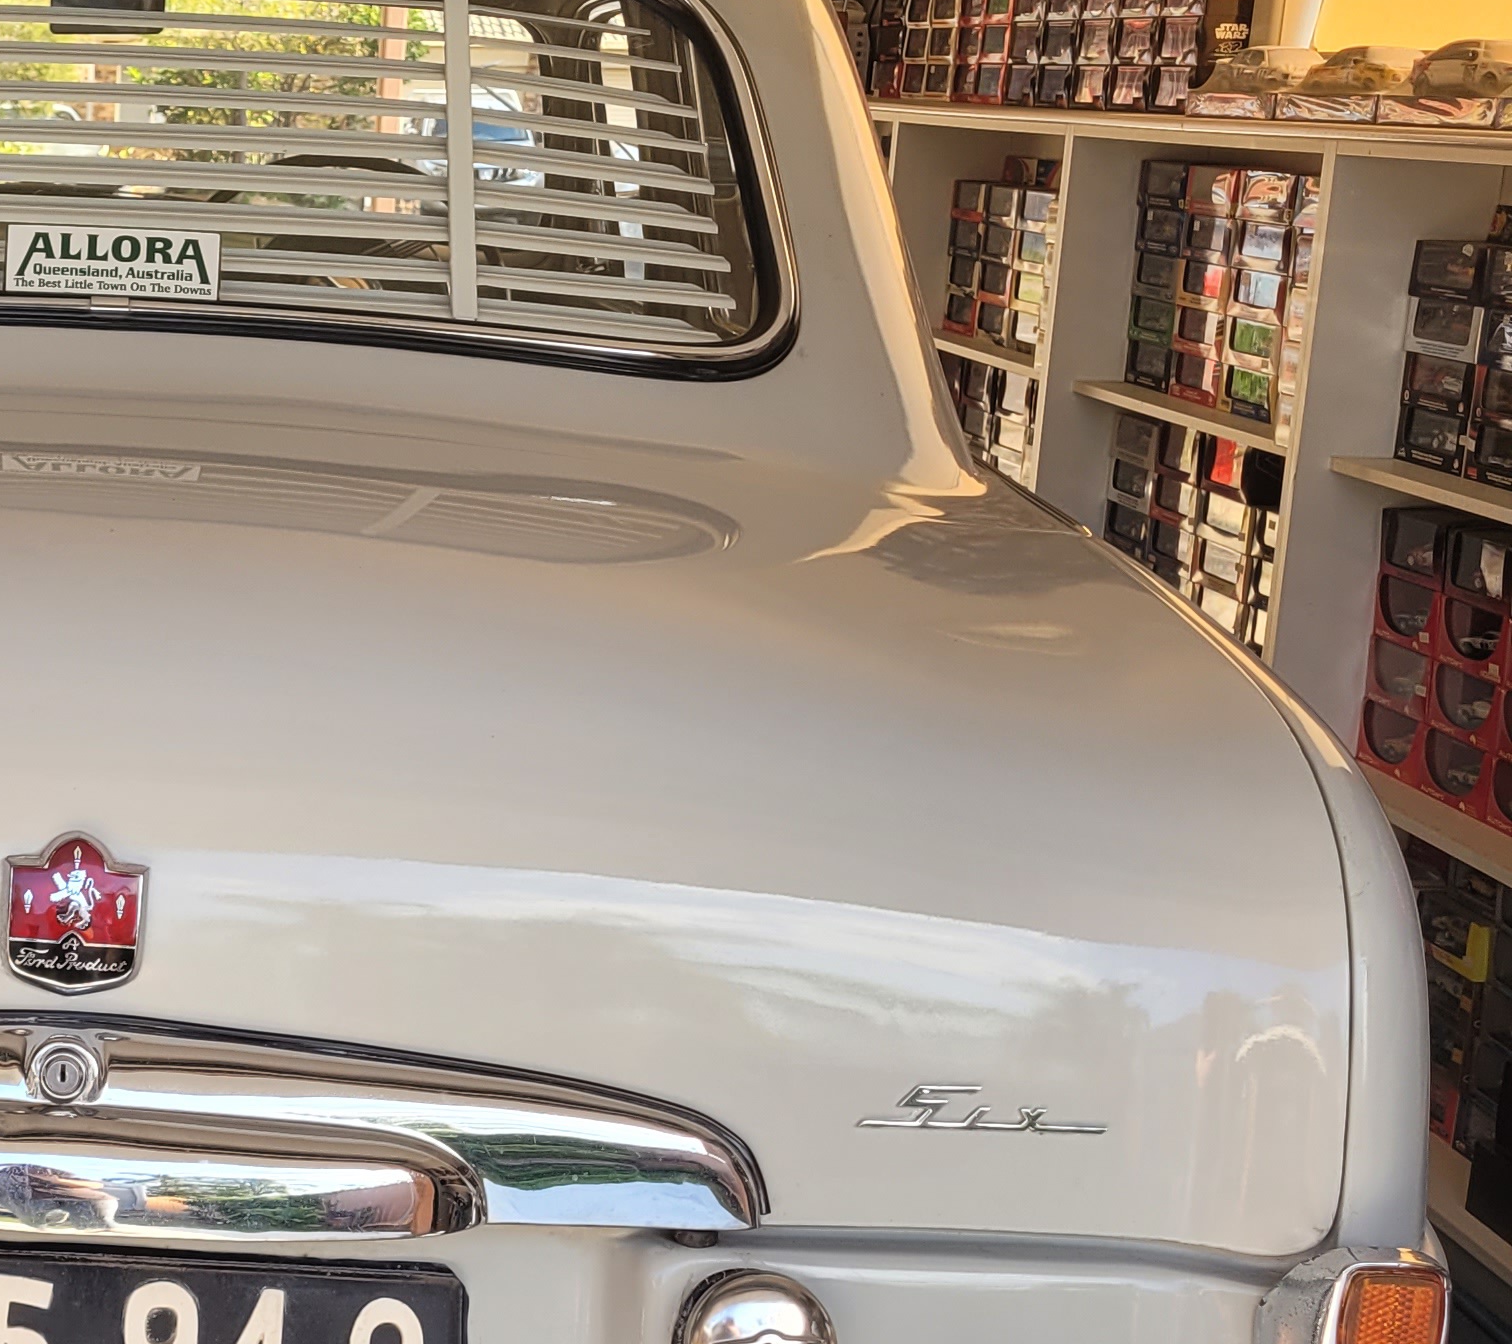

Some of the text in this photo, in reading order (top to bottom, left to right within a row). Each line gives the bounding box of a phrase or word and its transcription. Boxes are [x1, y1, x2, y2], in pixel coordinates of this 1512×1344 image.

[1215, 29, 1248, 40] WARS
[1219, 23, 1249, 32] STAR
[15, 231, 211, 285] ALLORA
[32, 262, 194, 282] Queensland, Australia
[14, 277, 212, 296] The Best Little Town On The Downs
[14, 948, 128, 972] Ford Product
